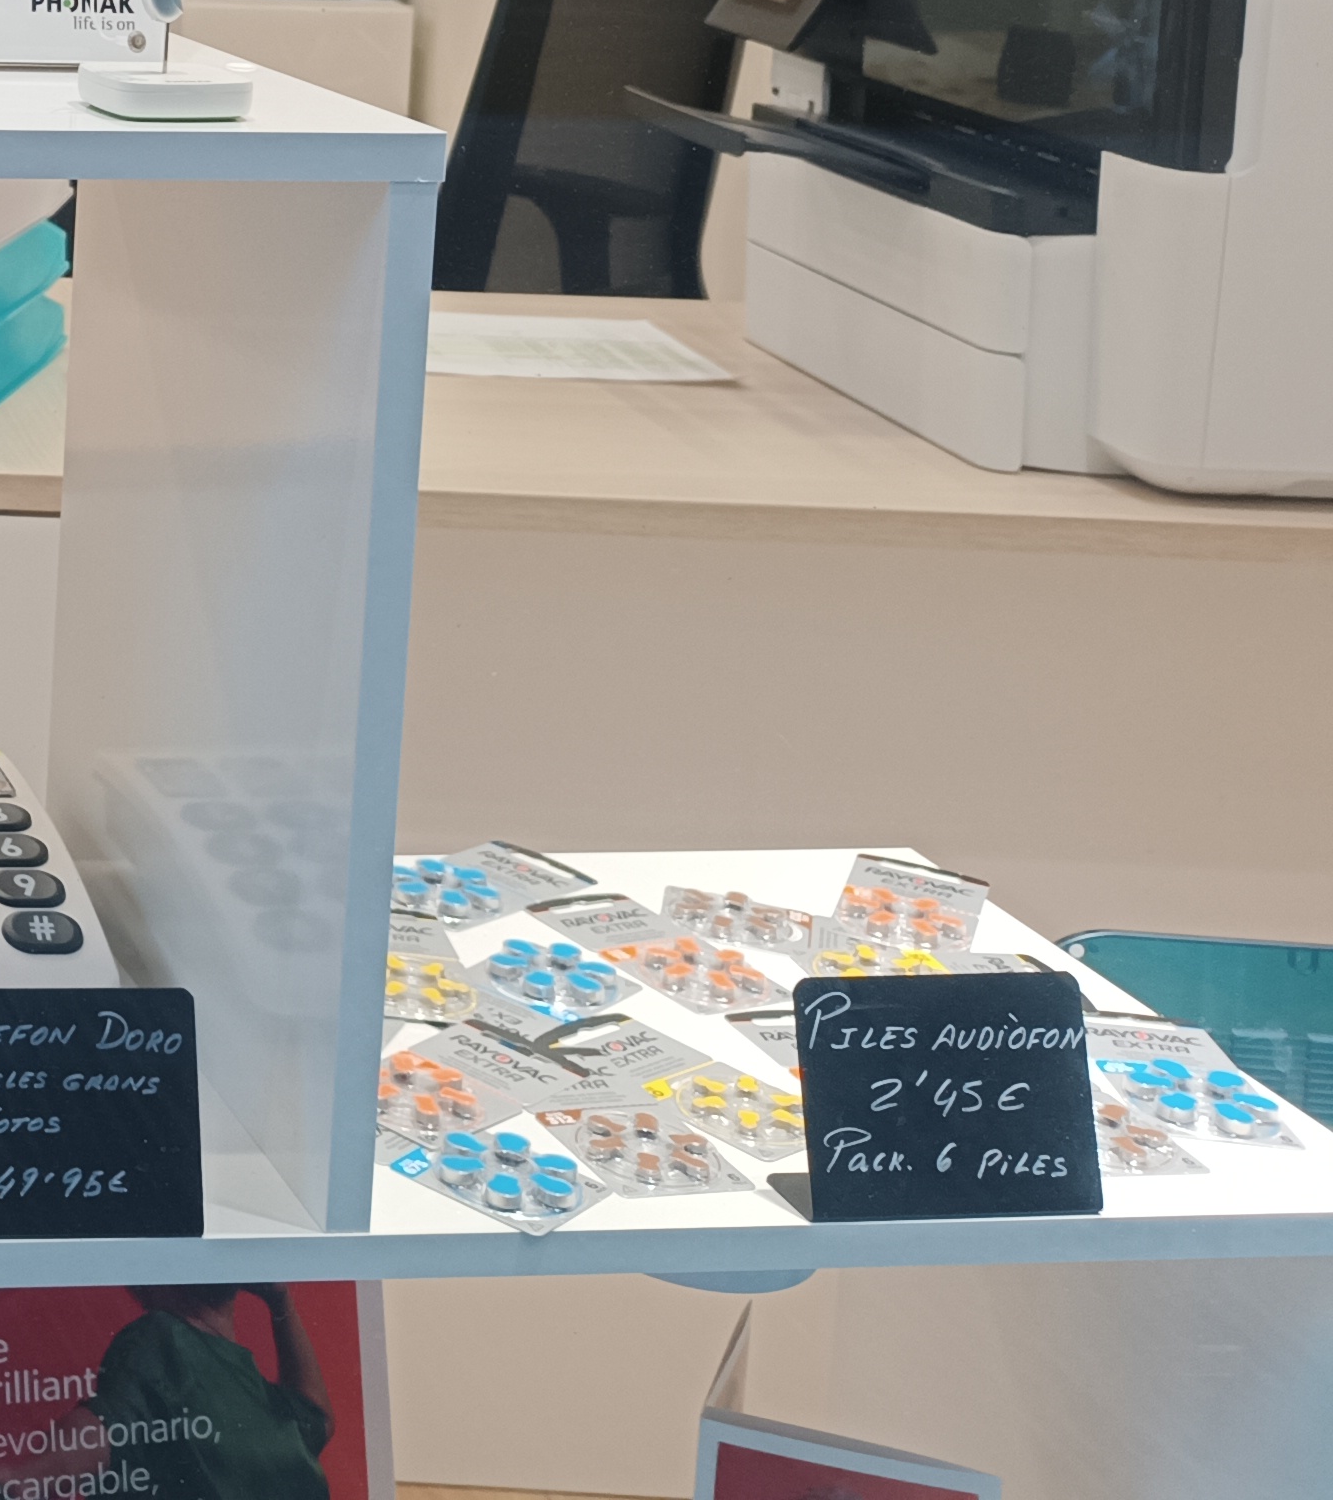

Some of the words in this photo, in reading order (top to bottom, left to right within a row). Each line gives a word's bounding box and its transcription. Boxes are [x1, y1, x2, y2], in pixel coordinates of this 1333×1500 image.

[73, 16, 97, 30] life
[102, 17, 113, 30] is
[116, 20, 135, 31] on
[0, 837, 23, 857] 6
[13, 873, 37, 897] 9
[864, 866, 976, 898] RAYOVAC
[560, 908, 649, 928] RAYOVAC
[590, 919, 648, 935] EXTRA
[95, 1010, 183, 1054] DORO
[804, 991, 919, 1050] PILES
[1085, 1027, 1203, 1046] RAYOVAC
[1112, 1040, 1191, 1054] EXTRA
[449, 1034, 558, 1084] RAYOVAC
[453, 1048, 527, 1083] EXTRA
[613, 1045, 664, 1069] EXTRA
[62, 1073, 162, 1094] GRANS
[935, 1142, 957, 1173] 6
